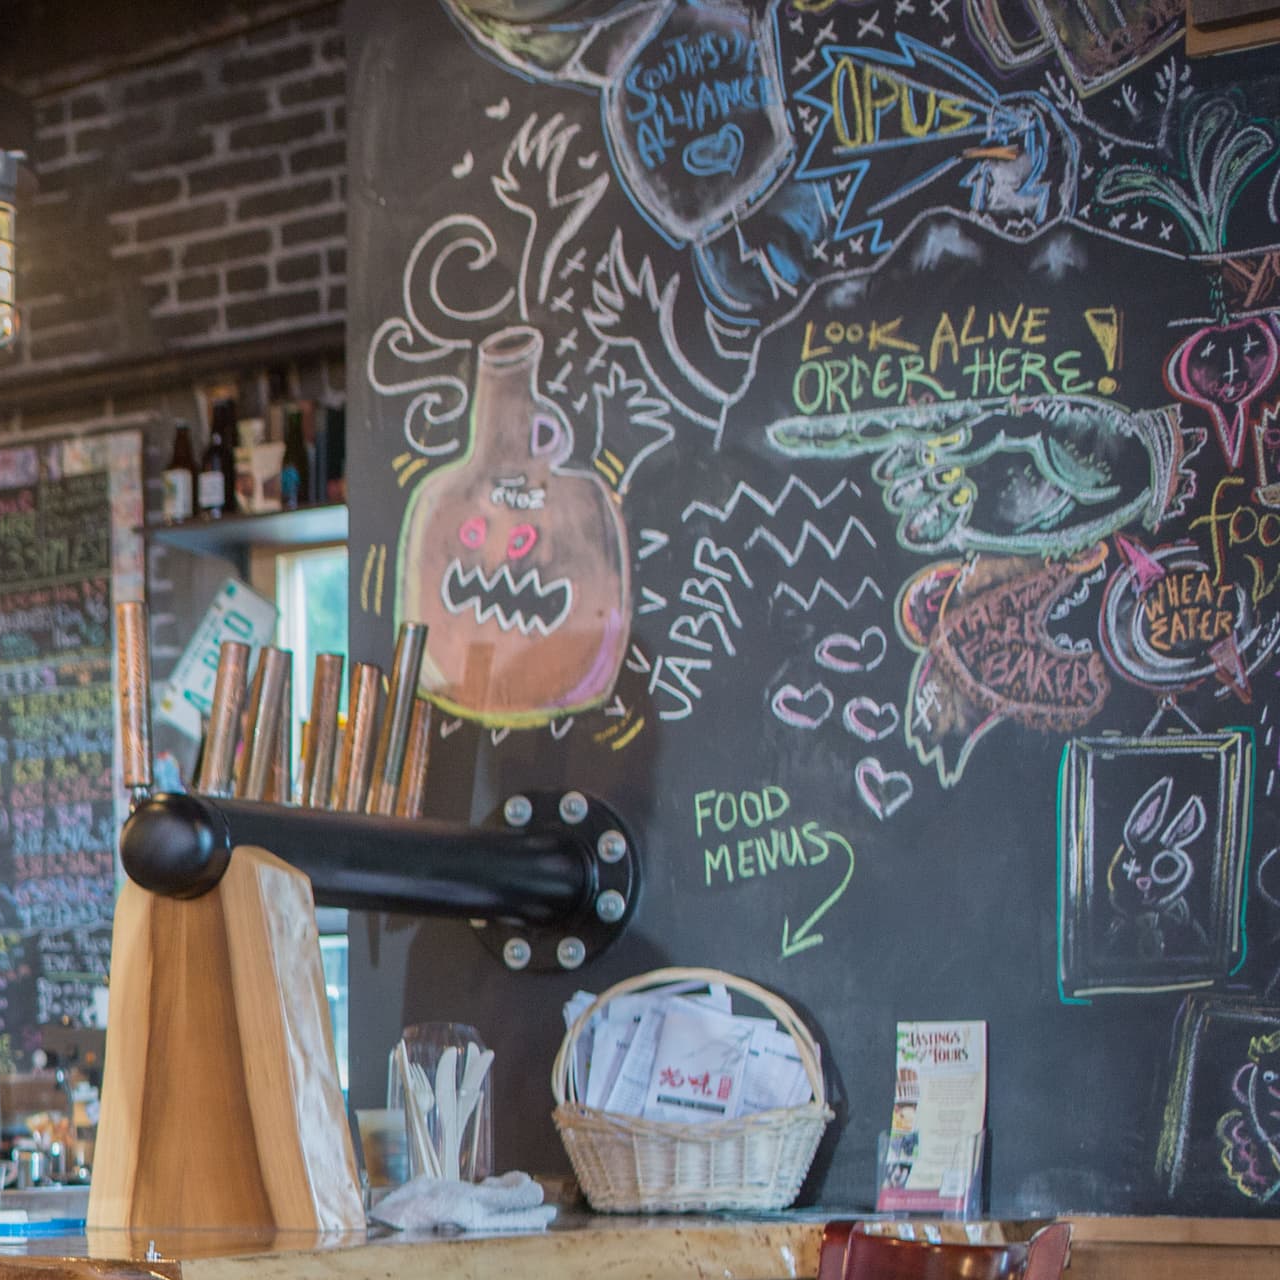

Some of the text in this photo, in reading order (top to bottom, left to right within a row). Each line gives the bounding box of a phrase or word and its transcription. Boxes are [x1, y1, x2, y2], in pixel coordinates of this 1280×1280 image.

[637, 76, 774, 169] ALLIANCE
[831, 54, 976, 148] OPUS
[801, 302, 1051, 373] LOOK ALIVE
[793, 354, 957, 415] ORDER
[1144, 571, 1234, 622] WHEAT
[1151, 607, 1233, 651] EATER
[695, 786, 790, 838] FOOD
[705, 821, 829, 887] MENUS
